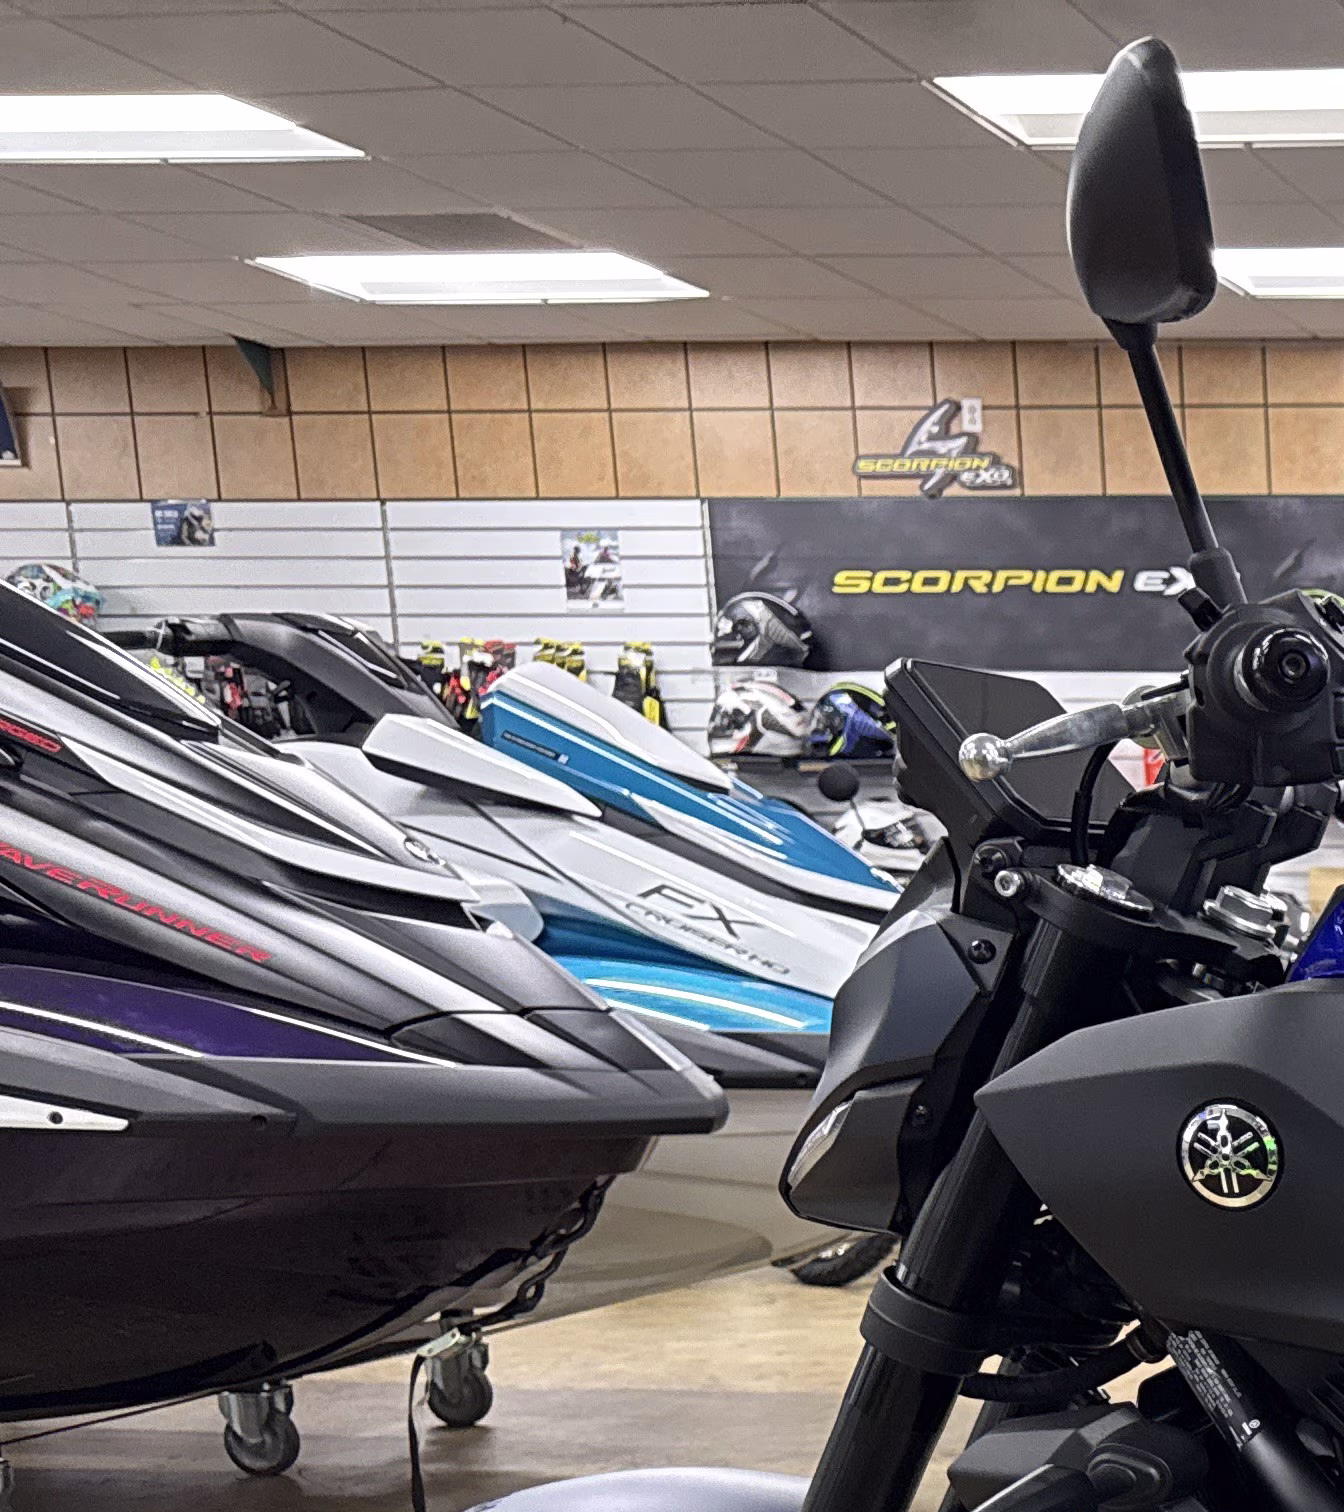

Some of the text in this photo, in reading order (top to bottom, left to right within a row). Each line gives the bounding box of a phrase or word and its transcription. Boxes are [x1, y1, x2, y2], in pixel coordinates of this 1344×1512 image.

[856, 456, 990, 474] SCORPION
[831, 569, 1125, 594] SCORPION
[0, 841, 272, 964] AVERUNNER
[637, 883, 766, 940] FX
